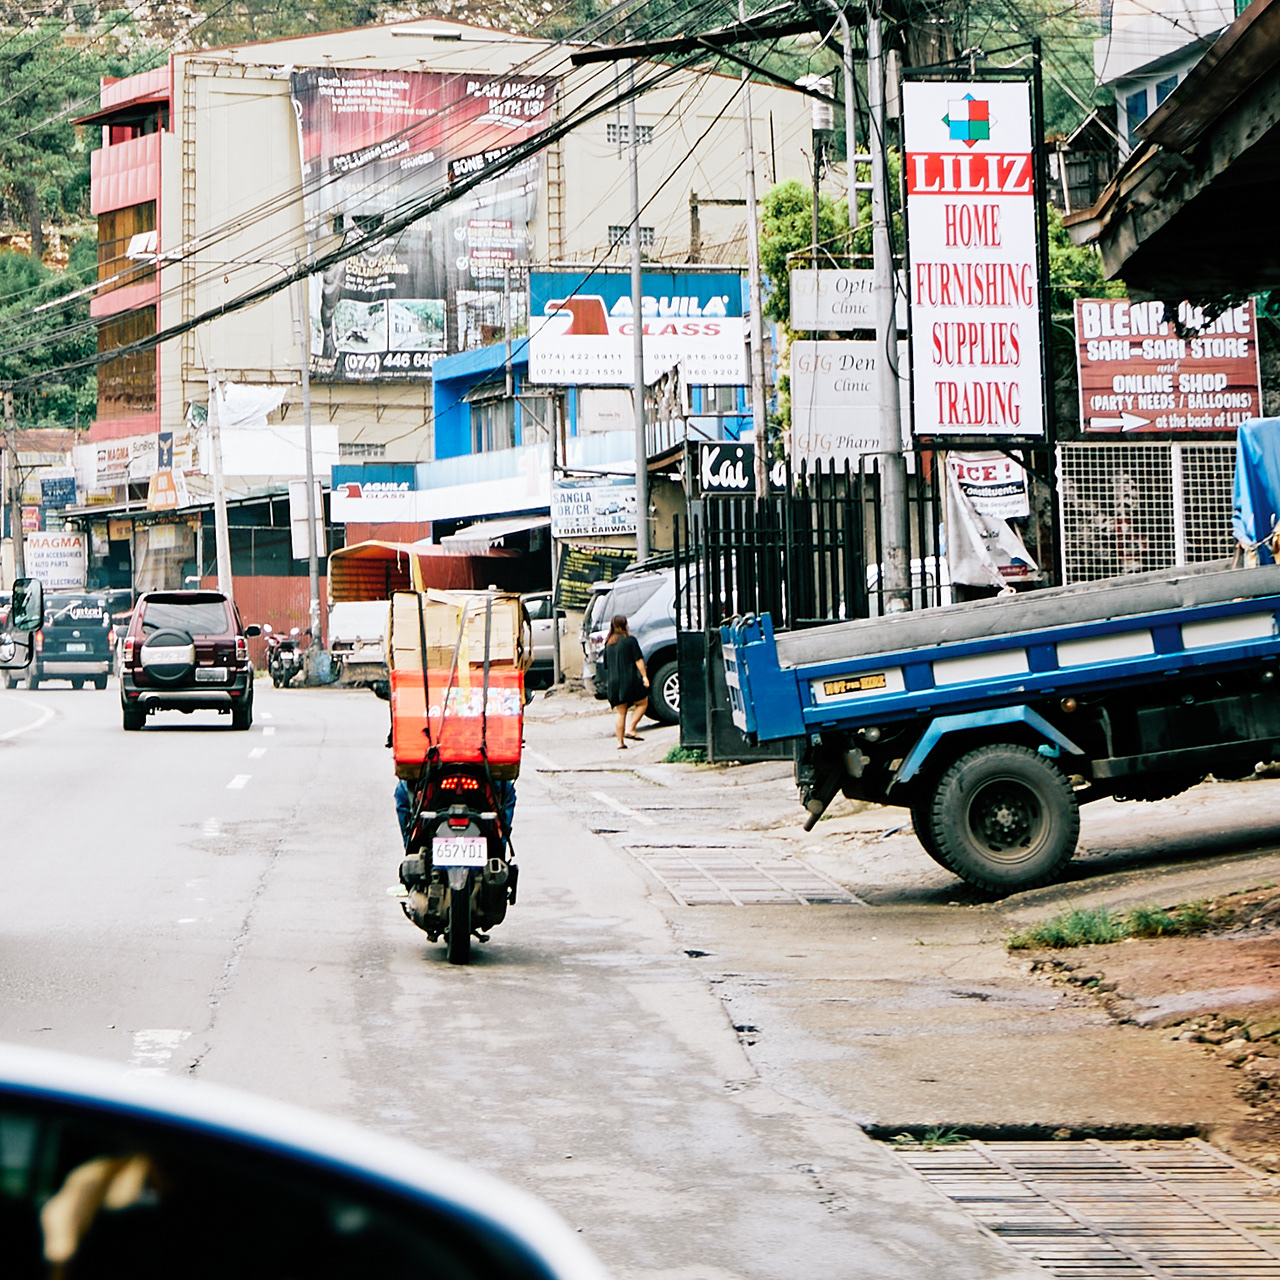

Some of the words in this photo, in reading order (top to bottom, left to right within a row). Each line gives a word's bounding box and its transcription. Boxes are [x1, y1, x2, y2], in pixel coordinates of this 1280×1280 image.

[489, 99, 522, 115] WITH
[912, 155, 1030, 193] LILIZ
[944, 203, 1001, 248] HOME
[835, 276, 875, 300] Opti
[915, 262, 1034, 308] FURNISHING
[831, 300, 869, 315] Clinic
[619, 323, 721, 336] GLASS
[932, 321, 1021, 366] SUPPLIES
[1086, 338, 1186, 361] SARI-SARI
[1191, 337, 1248, 359] STORE
[344, 353, 380, 372] (074)
[383, 352, 410, 368] 446
[536, 353, 566, 361] (074)
[838, 353, 876, 372] Den
[536, 368, 566, 376] (074)
[1156, 359, 1181, 373] and
[834, 379, 871, 393] Clinic
[1112, 374, 1174, 393] ONLINE
[1178, 373, 1228, 393] SHOP
[935, 380, 1022, 427] TRADING
[1090, 394, 1135, 411] (PARTY
[1138, 394, 1176, 410] NEEDS
[1187, 392, 1252, 410] BALLOONS)
[1155, 413, 1168, 428] at
[1169, 412, 1187, 428] the
[1187, 412, 1212, 428] back
[1213, 412, 1226, 428] of
[701, 444, 749, 490] Kai
[553, 492, 592, 504] SANGLA
[557, 504, 590, 516] OR/CR
[29, 537, 82, 548] MAGMA
[824, 680, 846, 695] NOT
